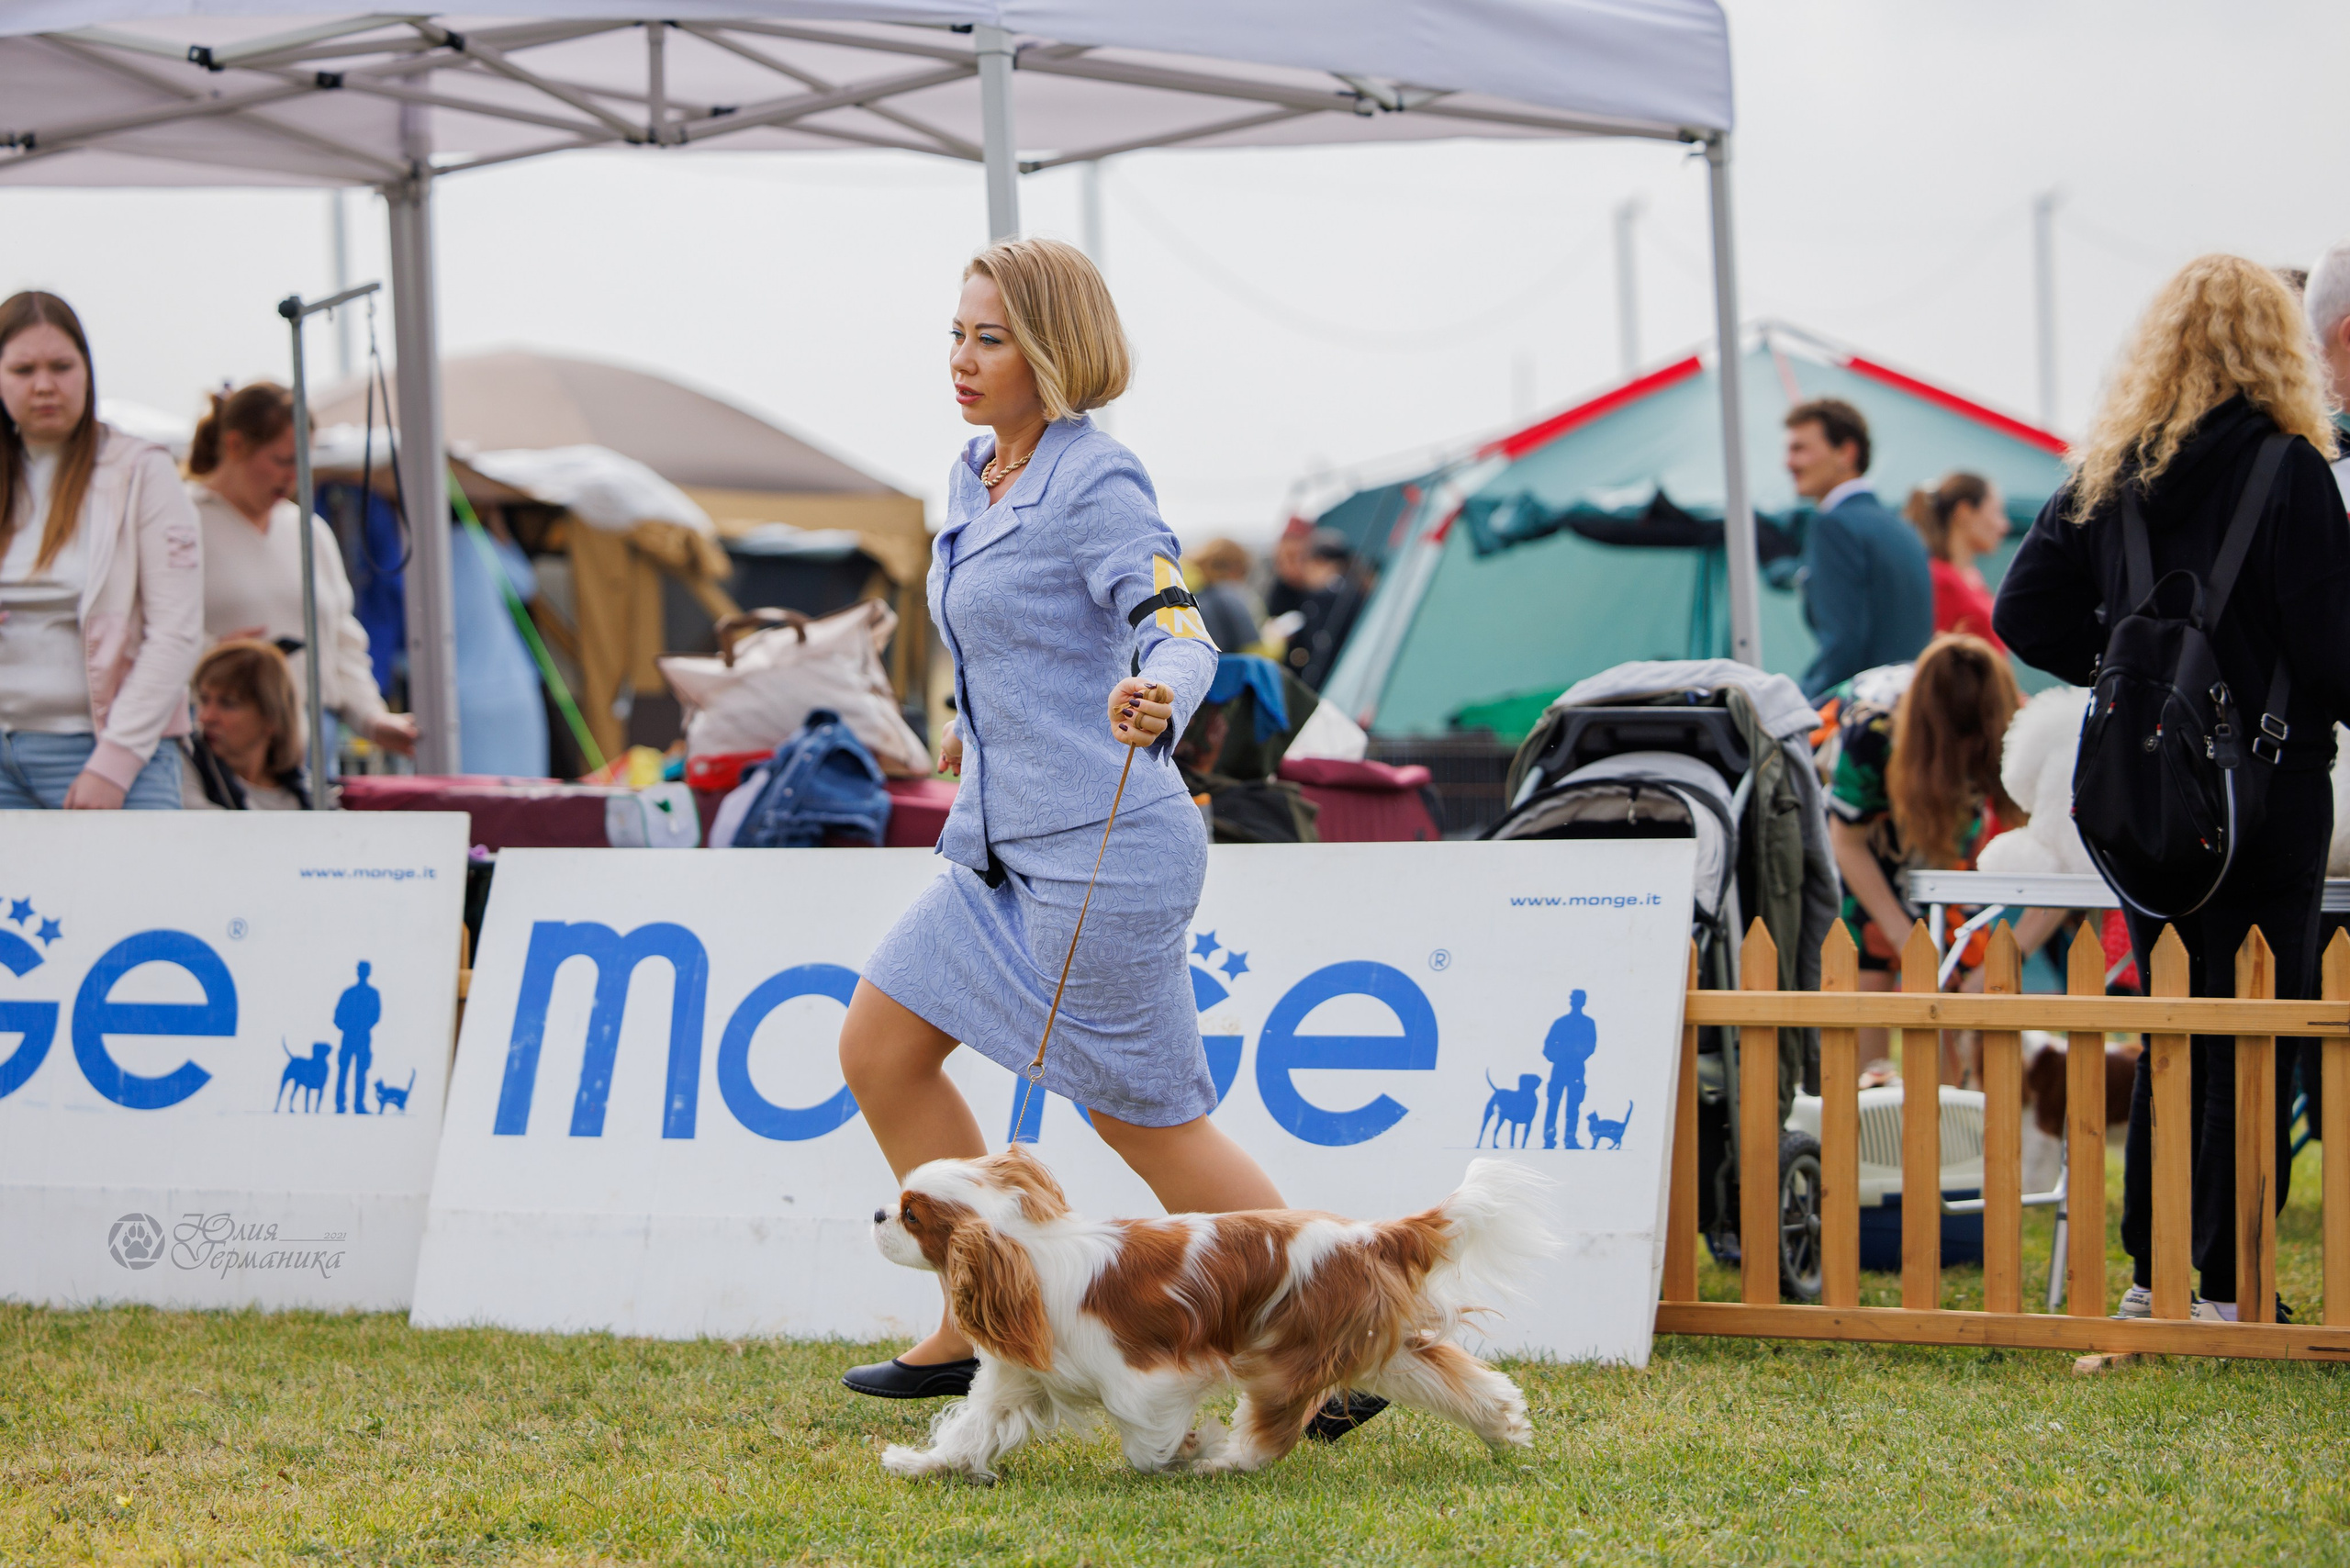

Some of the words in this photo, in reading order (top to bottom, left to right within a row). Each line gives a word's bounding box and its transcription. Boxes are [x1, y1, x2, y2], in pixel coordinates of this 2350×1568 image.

[299, 866, 436, 882] www.monge.it
[1510, 893, 1662, 909] www.monge.it
[493, 921, 1439, 1148] moe
